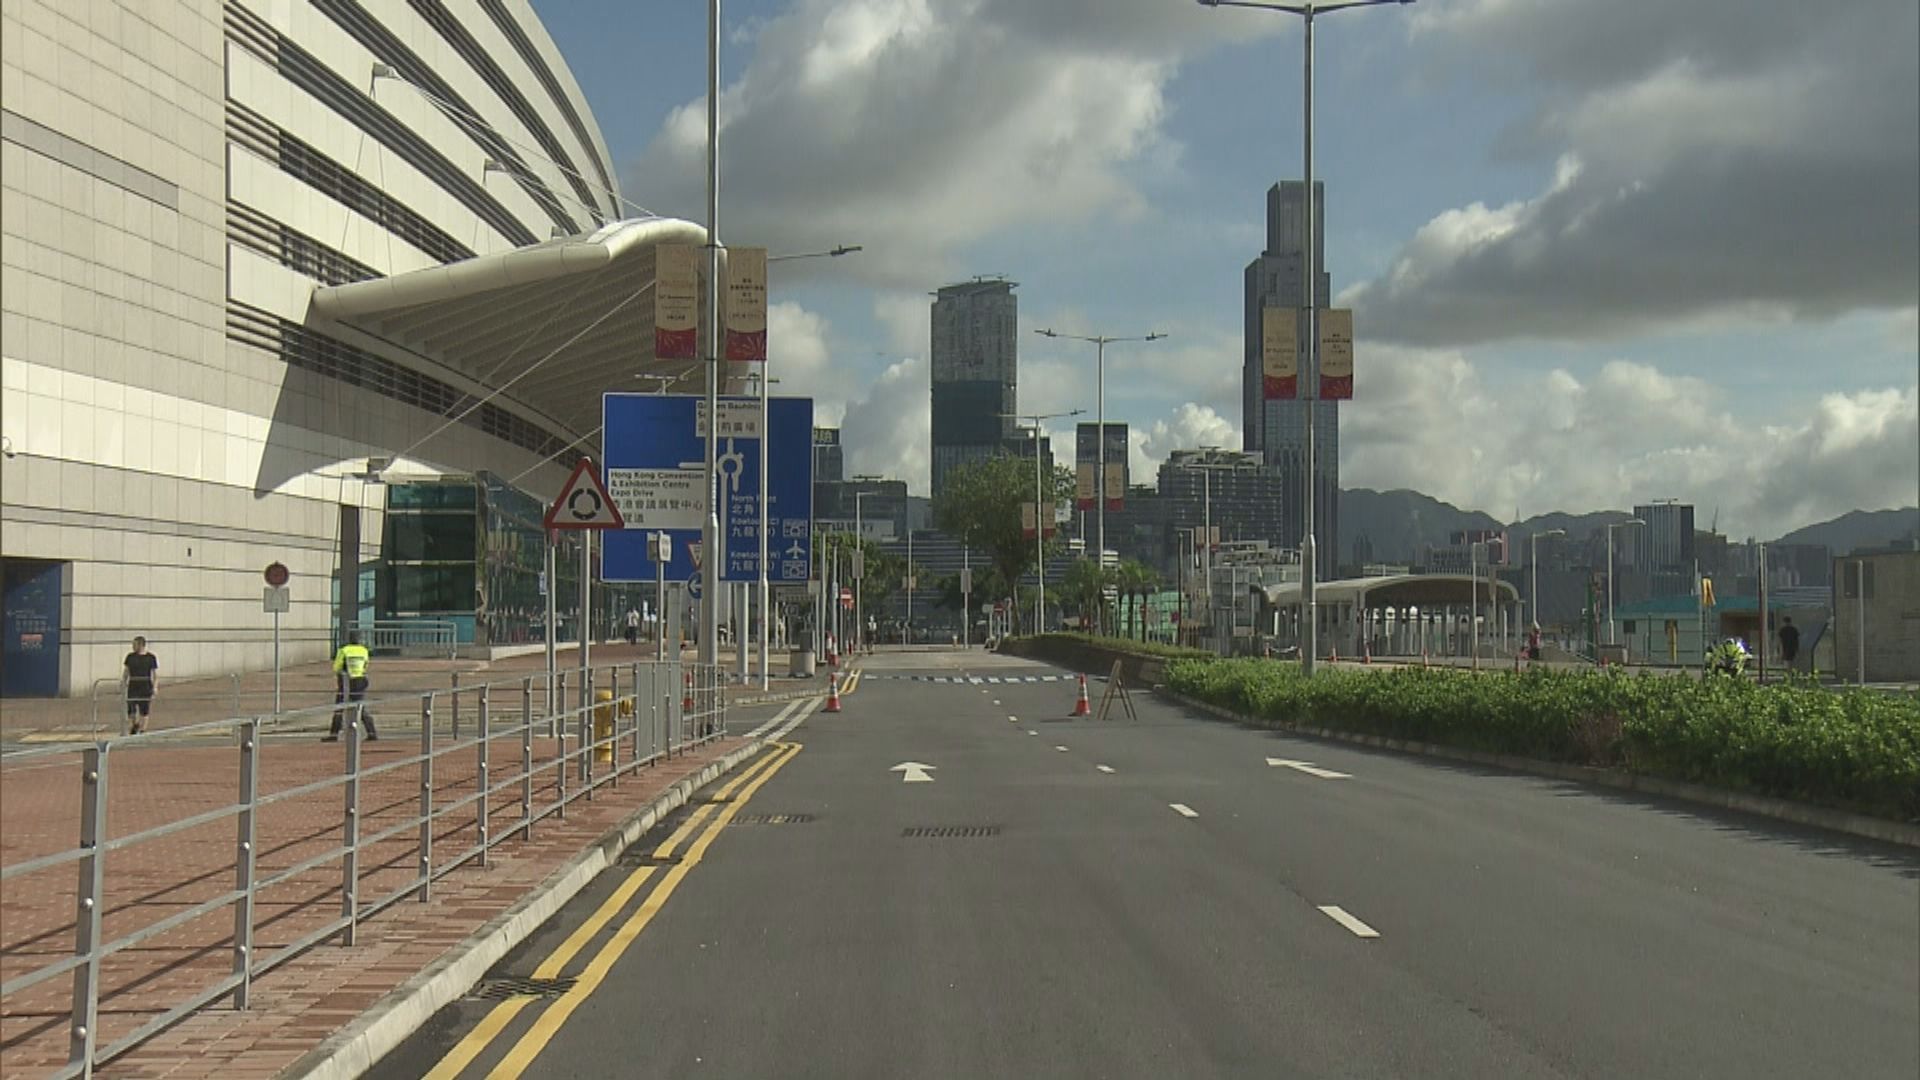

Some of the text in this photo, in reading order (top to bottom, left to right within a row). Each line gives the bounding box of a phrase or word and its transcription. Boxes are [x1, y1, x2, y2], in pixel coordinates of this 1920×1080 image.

[611, 471, 704, 480] Hong Kong Convention
[619, 480, 660, 488] Exhibition
[662, 480, 690, 489] Centre
[611, 489, 654, 497] Expo Drive
